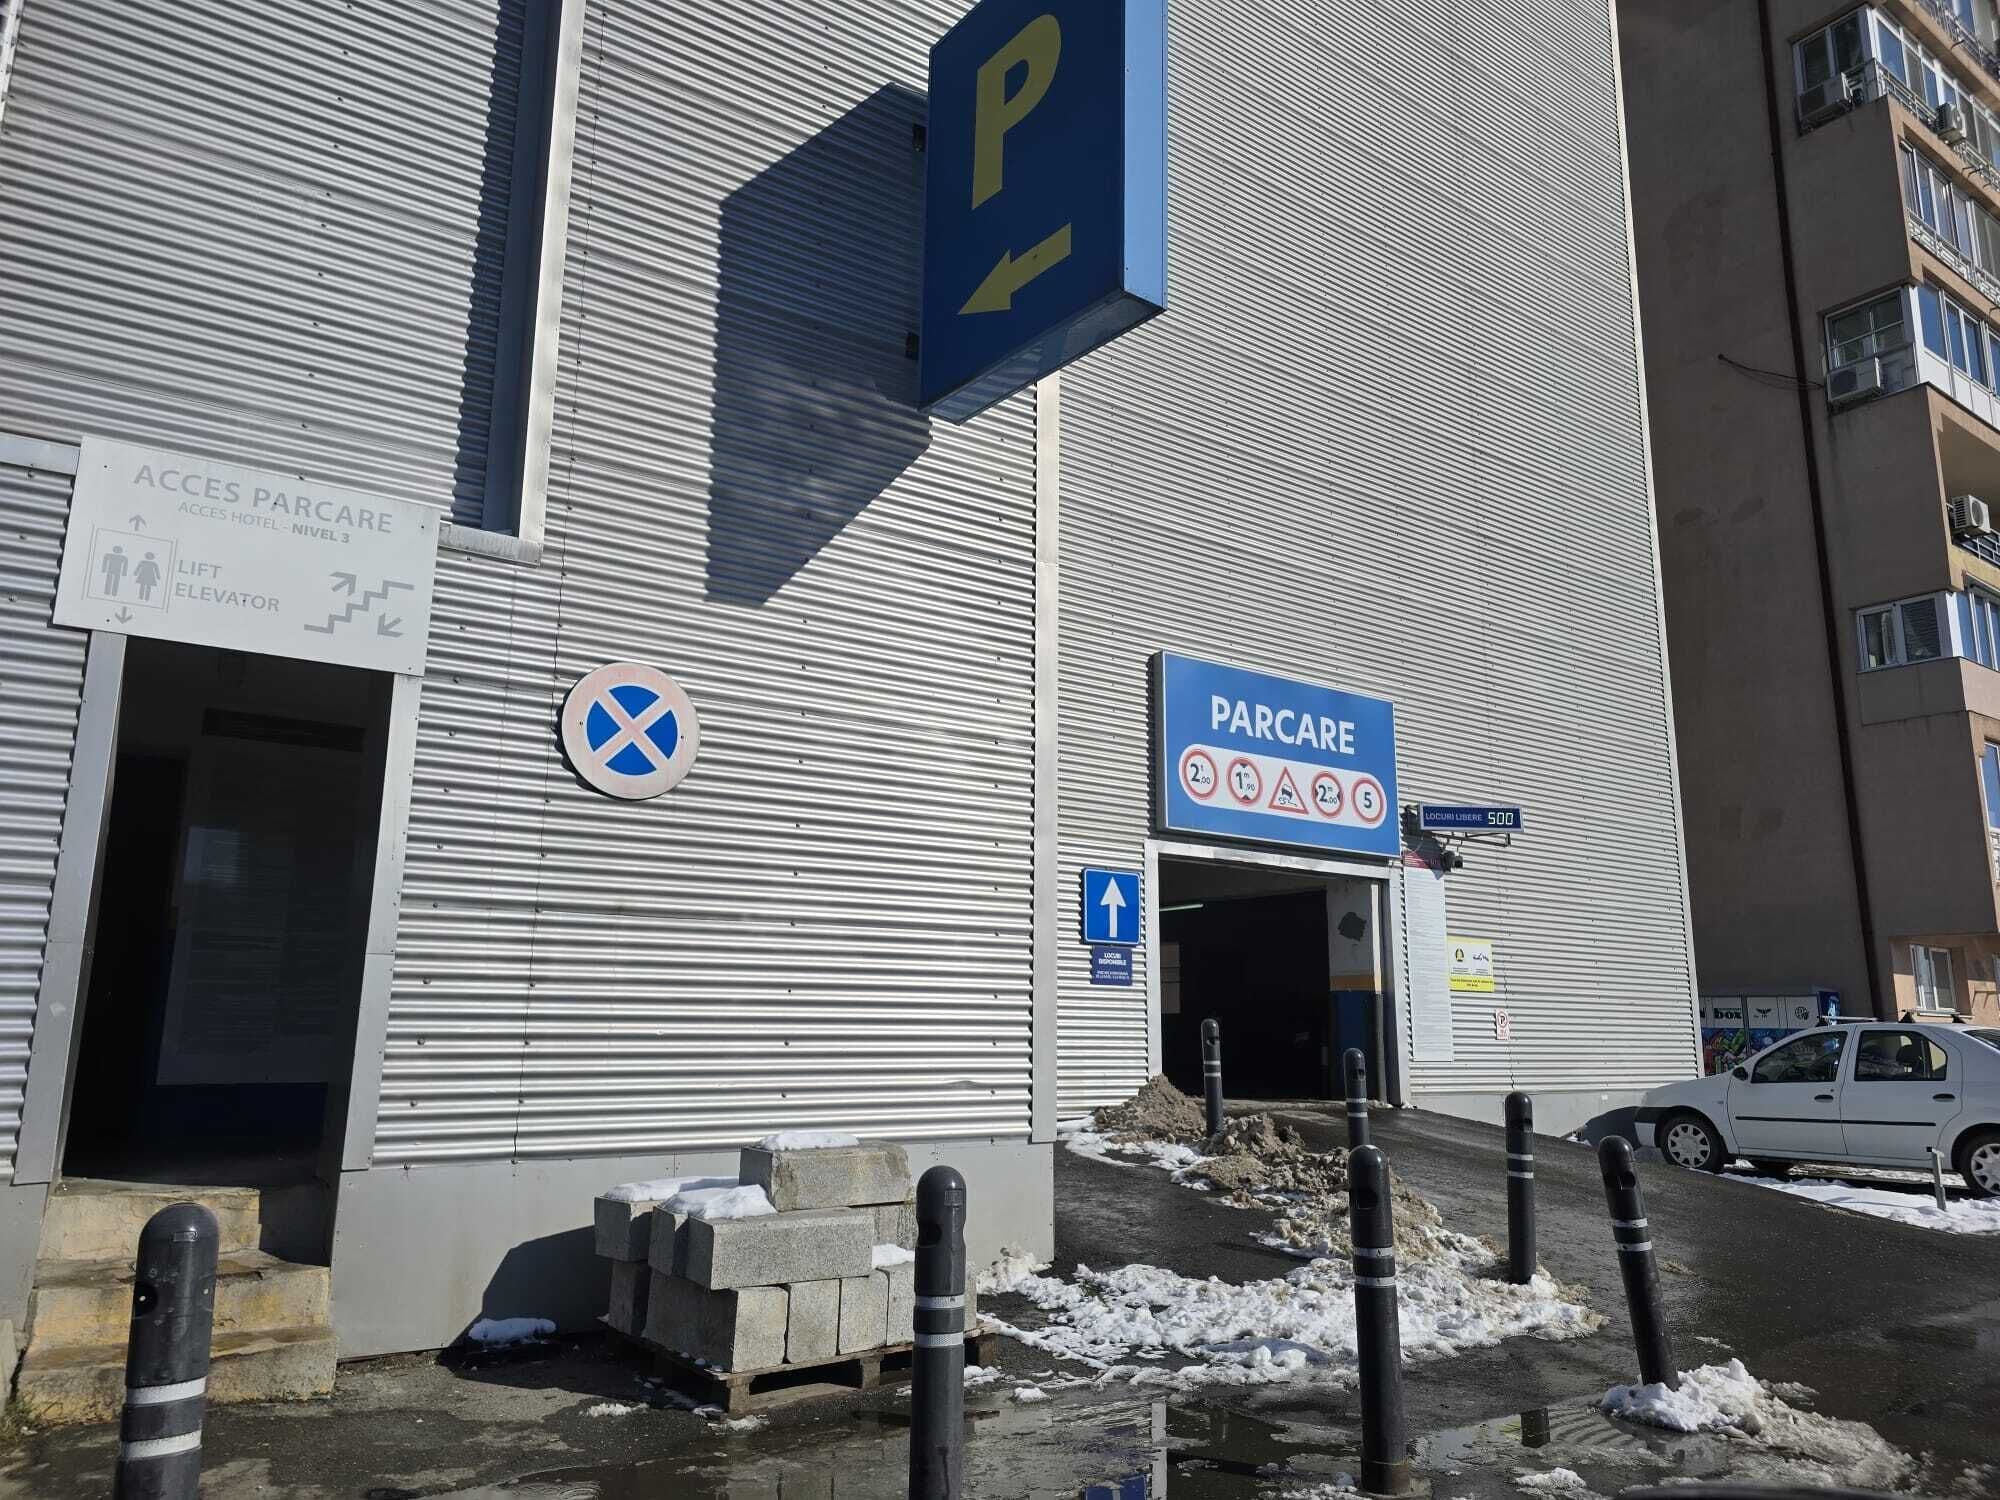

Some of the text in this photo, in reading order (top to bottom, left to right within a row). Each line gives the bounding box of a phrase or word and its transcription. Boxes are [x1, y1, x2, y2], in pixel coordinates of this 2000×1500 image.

[972, 14, 1062, 210] P
[133, 464, 393, 534] ACCES PARCARE
[178, 501, 227, 520] ACCES
[231, 511, 279, 531] HOTEL
[291, 523, 338, 542] NIVEL
[340, 532, 351, 544] 3
[178, 559, 222, 579] LIFT
[175, 582, 280, 612] ELEVATOR
[1211, 695, 1355, 755] PARCARE
[1363, 791, 1373, 809] 5
[1425, 811, 1514, 826] LOCURI LIBERE 500
